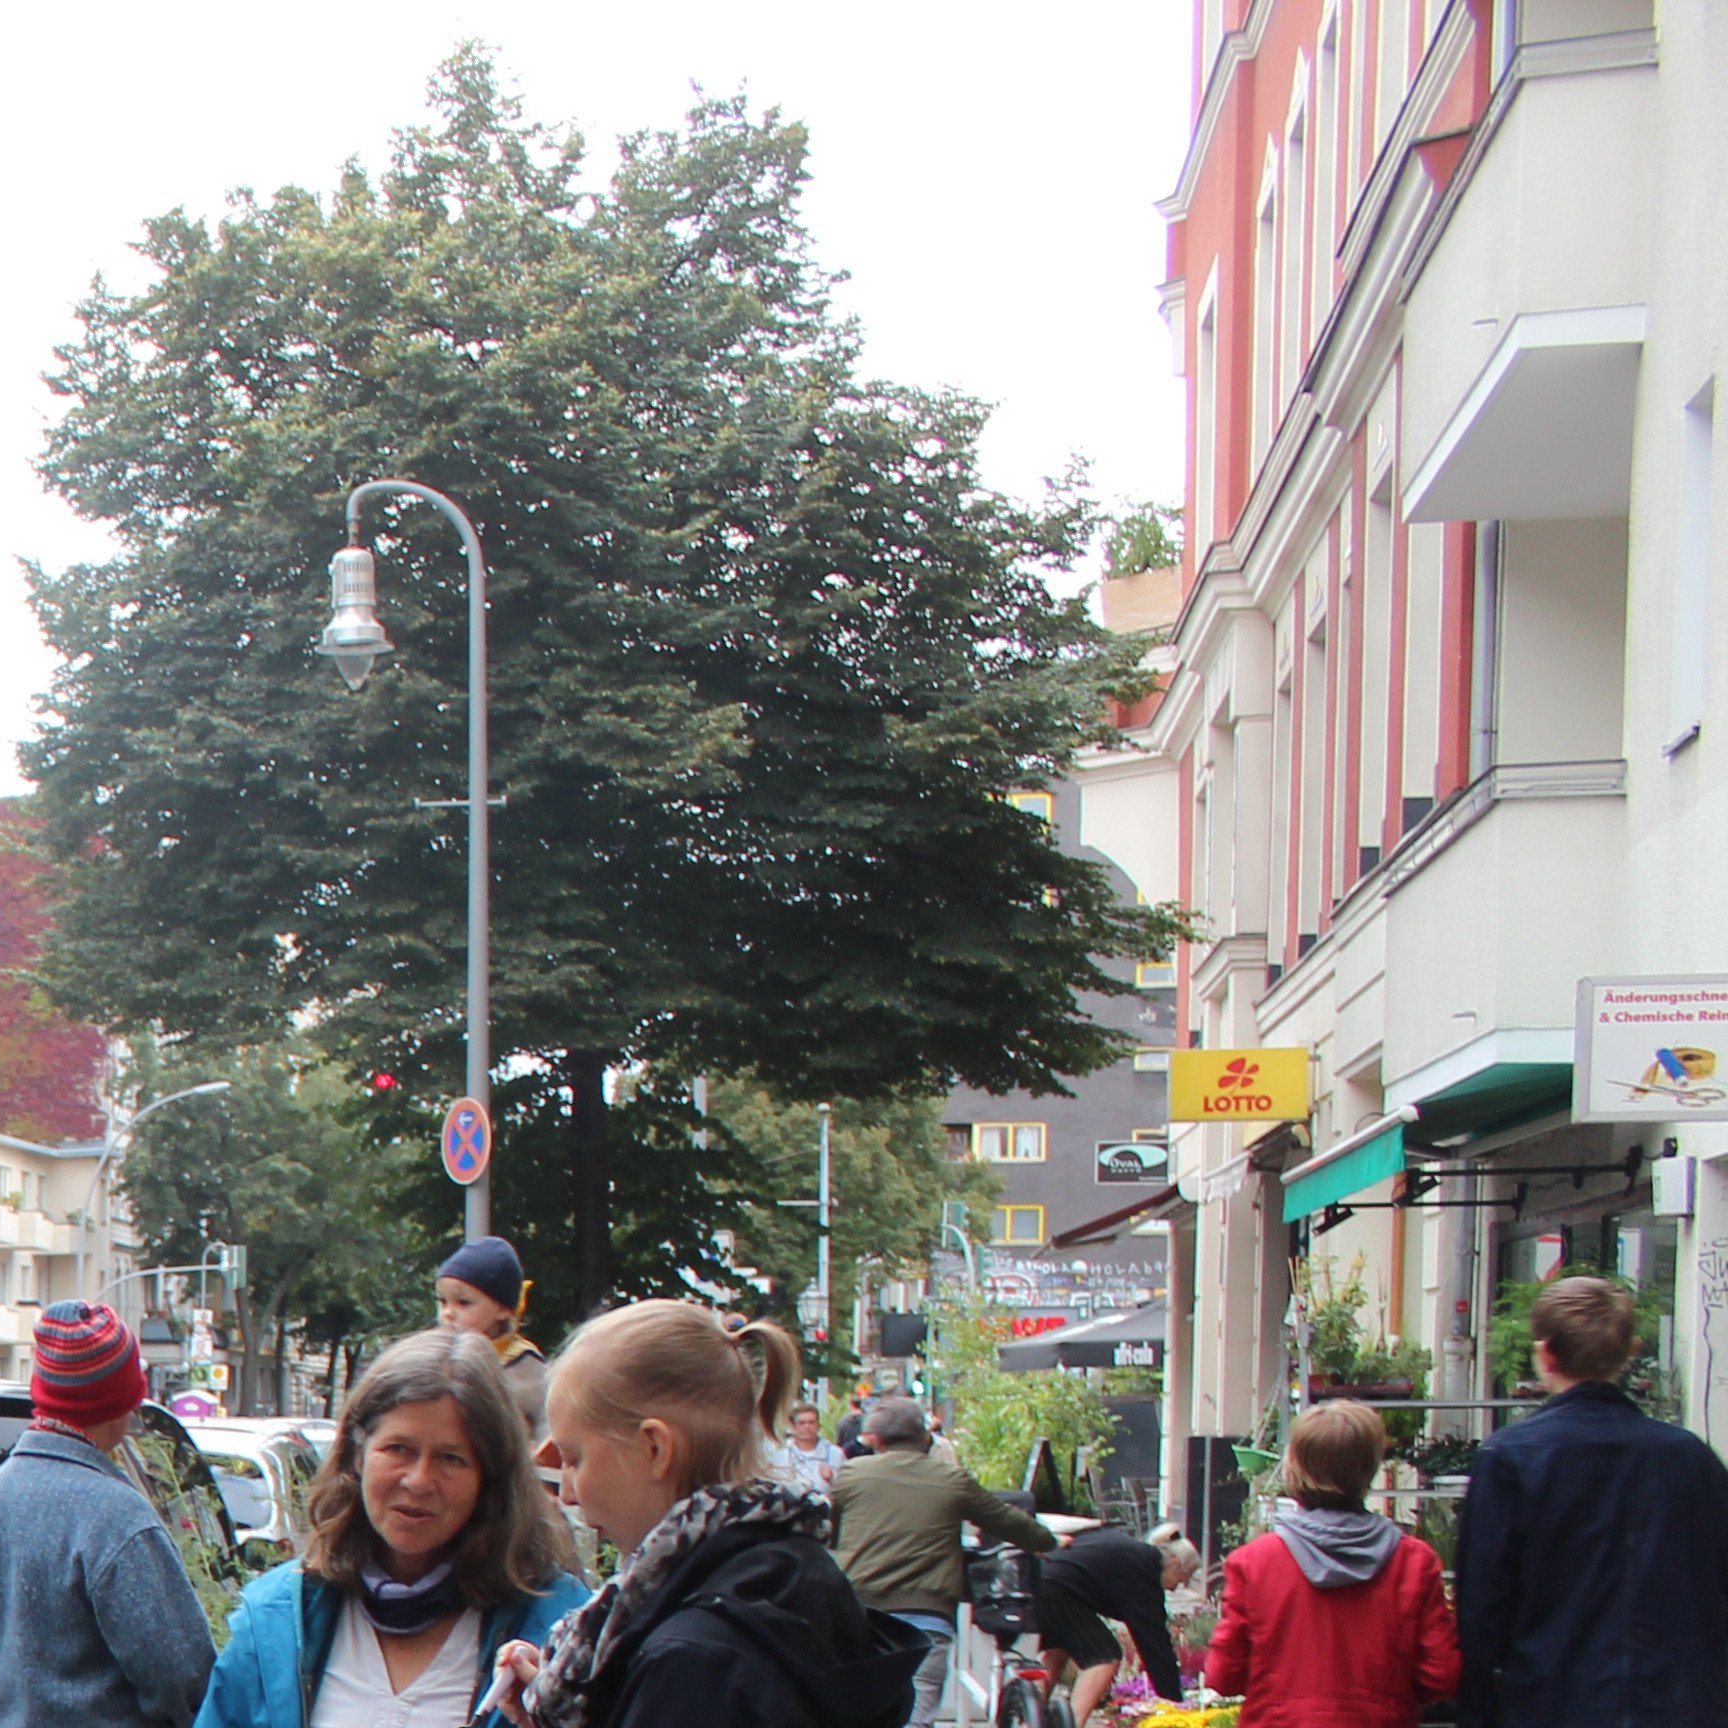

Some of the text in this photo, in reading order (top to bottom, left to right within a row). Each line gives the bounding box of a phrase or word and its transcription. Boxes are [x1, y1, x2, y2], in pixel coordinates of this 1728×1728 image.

[1599, 1012, 1610, 1023] &
[1614, 1010, 1694, 1023] Chemische
[1203, 1094, 1272, 1113] LOTTO
